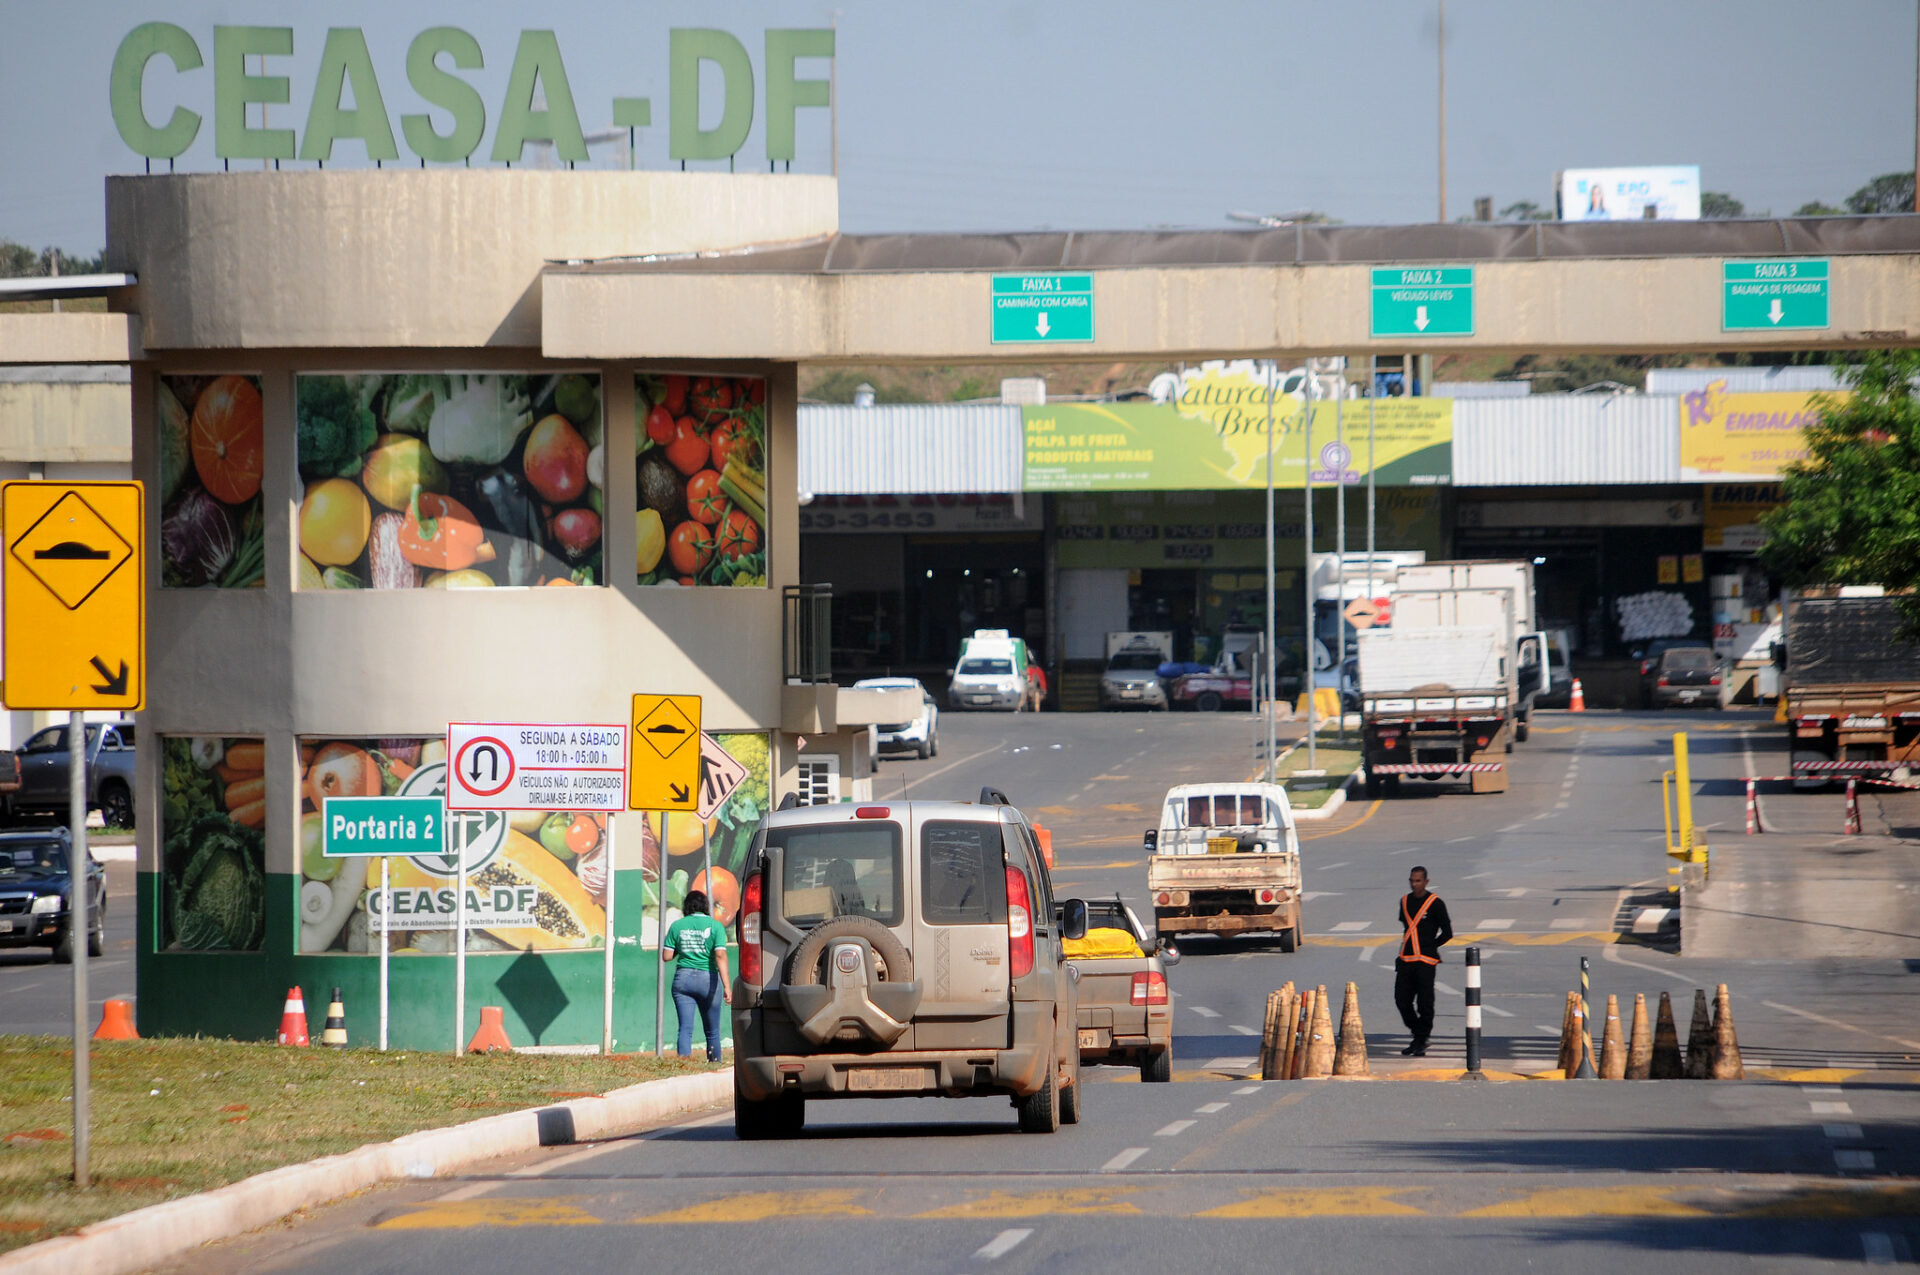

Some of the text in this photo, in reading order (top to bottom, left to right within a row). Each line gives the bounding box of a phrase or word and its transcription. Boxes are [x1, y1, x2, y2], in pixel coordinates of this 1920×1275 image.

[110, 21, 835, 163] CEASA-DF
[1401, 270, 1443, 284] FAIXA 2
[1755, 264, 1797, 278] FAIXA 3
[1022, 277, 1062, 291] FAIXA 1
[1731, 283, 1821, 297] BALANÇA DE PESAGEM
[1391, 288, 1454, 301] VEÍCULOS LEVES
[997, 296, 1088, 308] CAMINHÃO COM CARGA
[1151, 376, 1281, 413] Natural
[1027, 416, 1056, 434] AÇAÍ
[1212, 408, 1318, 437] Brasil
[1027, 433, 1127, 448] POLPA DE FRUTA
[1027, 449, 1154, 464] PRODUTOS NATURAIS
[520, 729, 620, 746] SEGUNDA A SÁBADO
[536, 750, 559, 763] 18:00
[561, 750, 567, 763] h
[575, 750, 599, 764] 05:00
[601, 750, 608, 764] h
[519, 774, 553, 788] VEÍCULOS
[554, 775, 569, 788] NÃO
[529, 792, 567, 803] DIRIJAM-SE
[574, 793, 608, 804] PORTARIA
[332, 814, 434, 840] Portaria 2
[1182, 867, 1261, 878] KIA MOTORS
